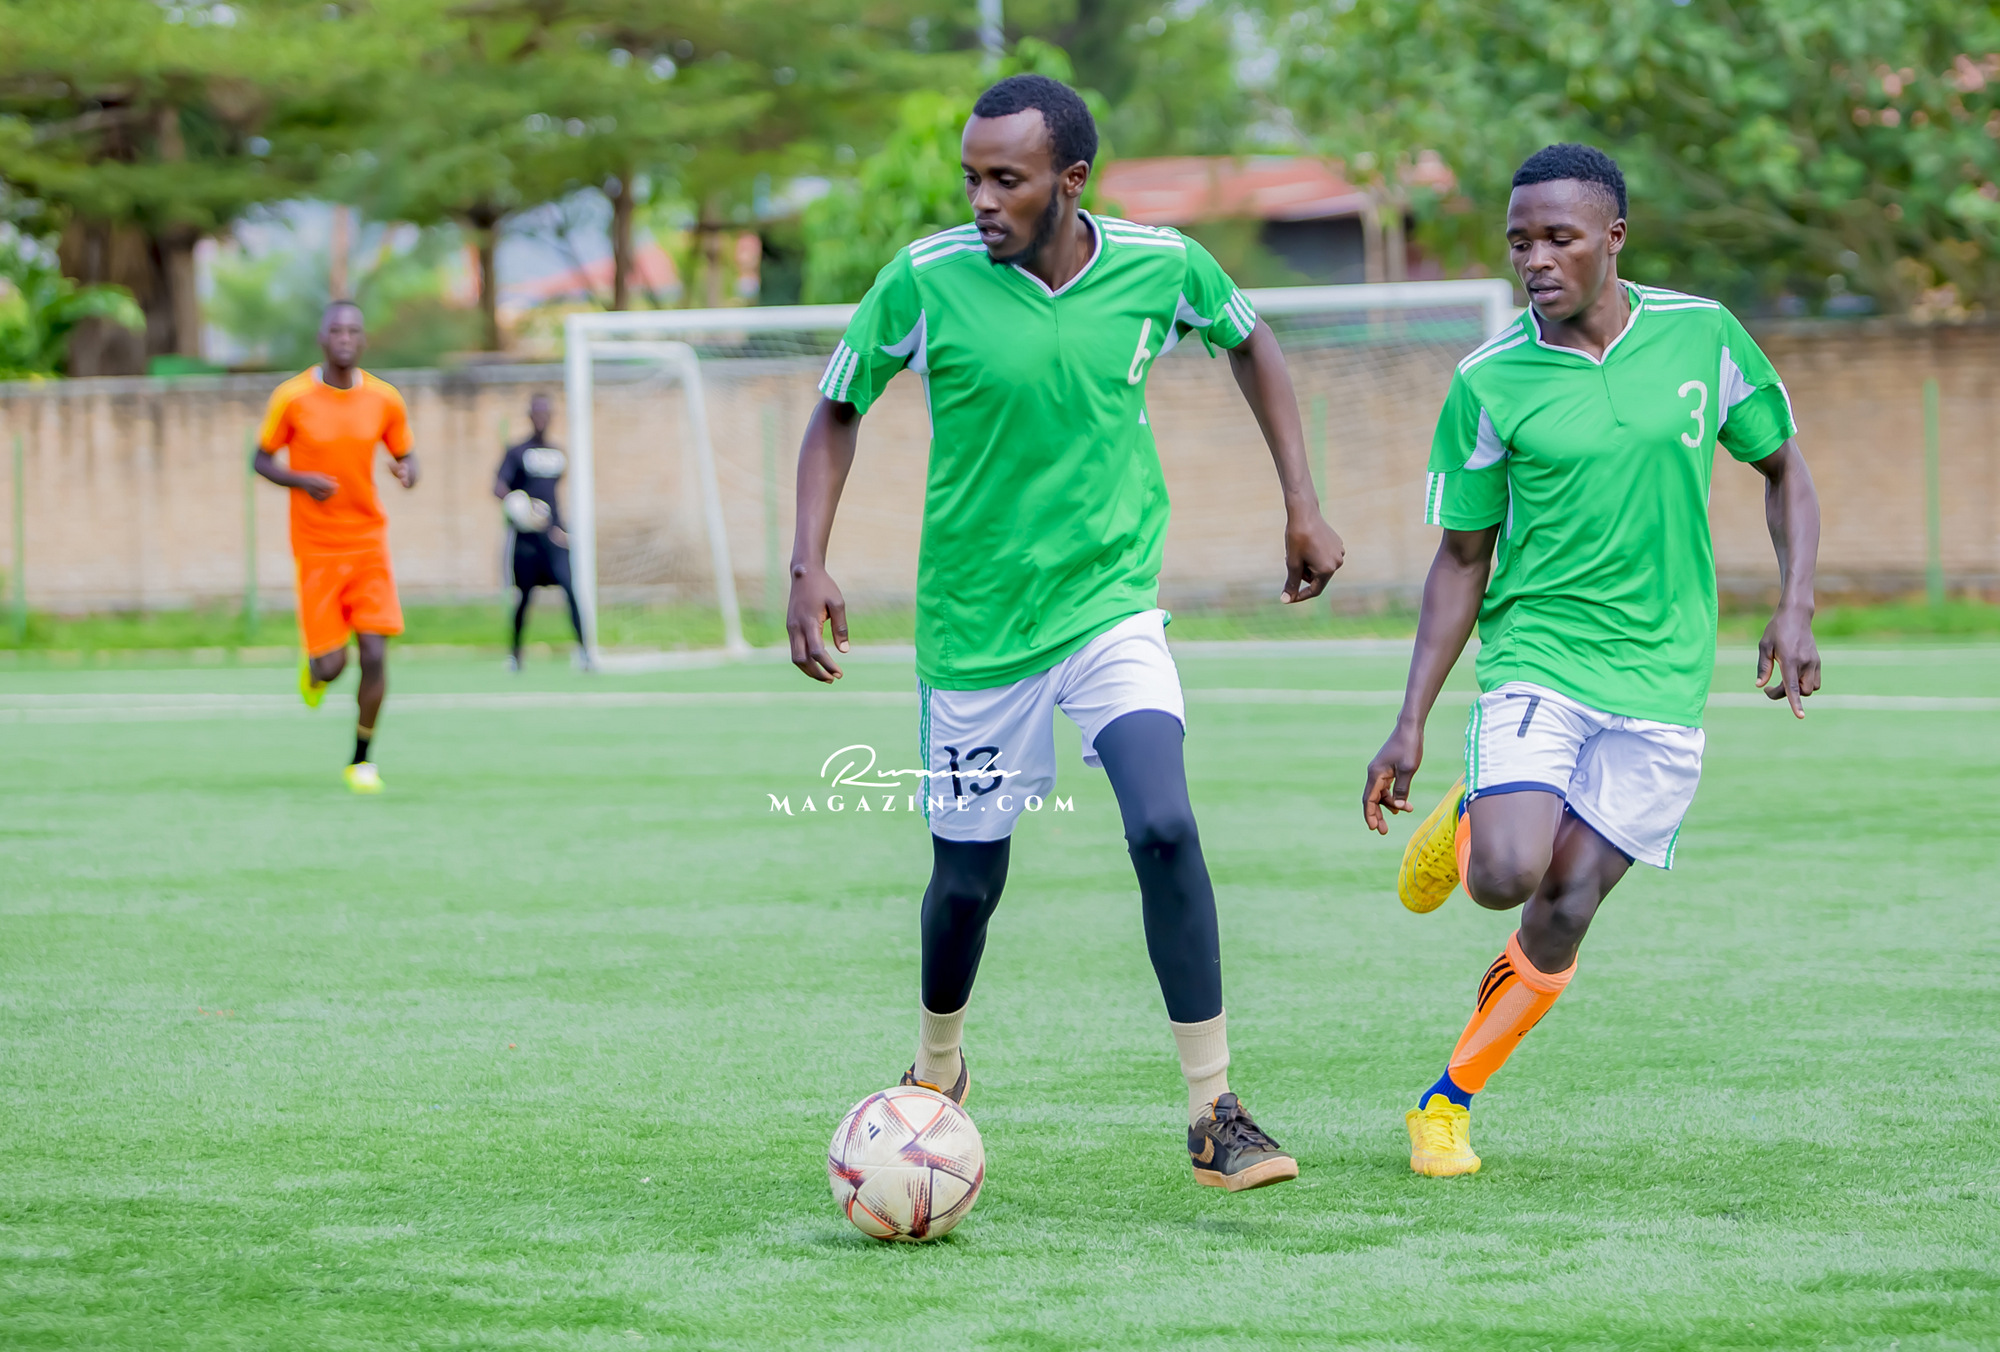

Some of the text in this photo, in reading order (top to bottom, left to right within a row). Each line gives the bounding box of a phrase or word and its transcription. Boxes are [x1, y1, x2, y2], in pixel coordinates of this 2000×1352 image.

[1127, 317, 1152, 385] 6
[1678, 380, 1708, 448] 3
[1506, 693, 1541, 738] 7
[944, 745, 1004, 800] 13
